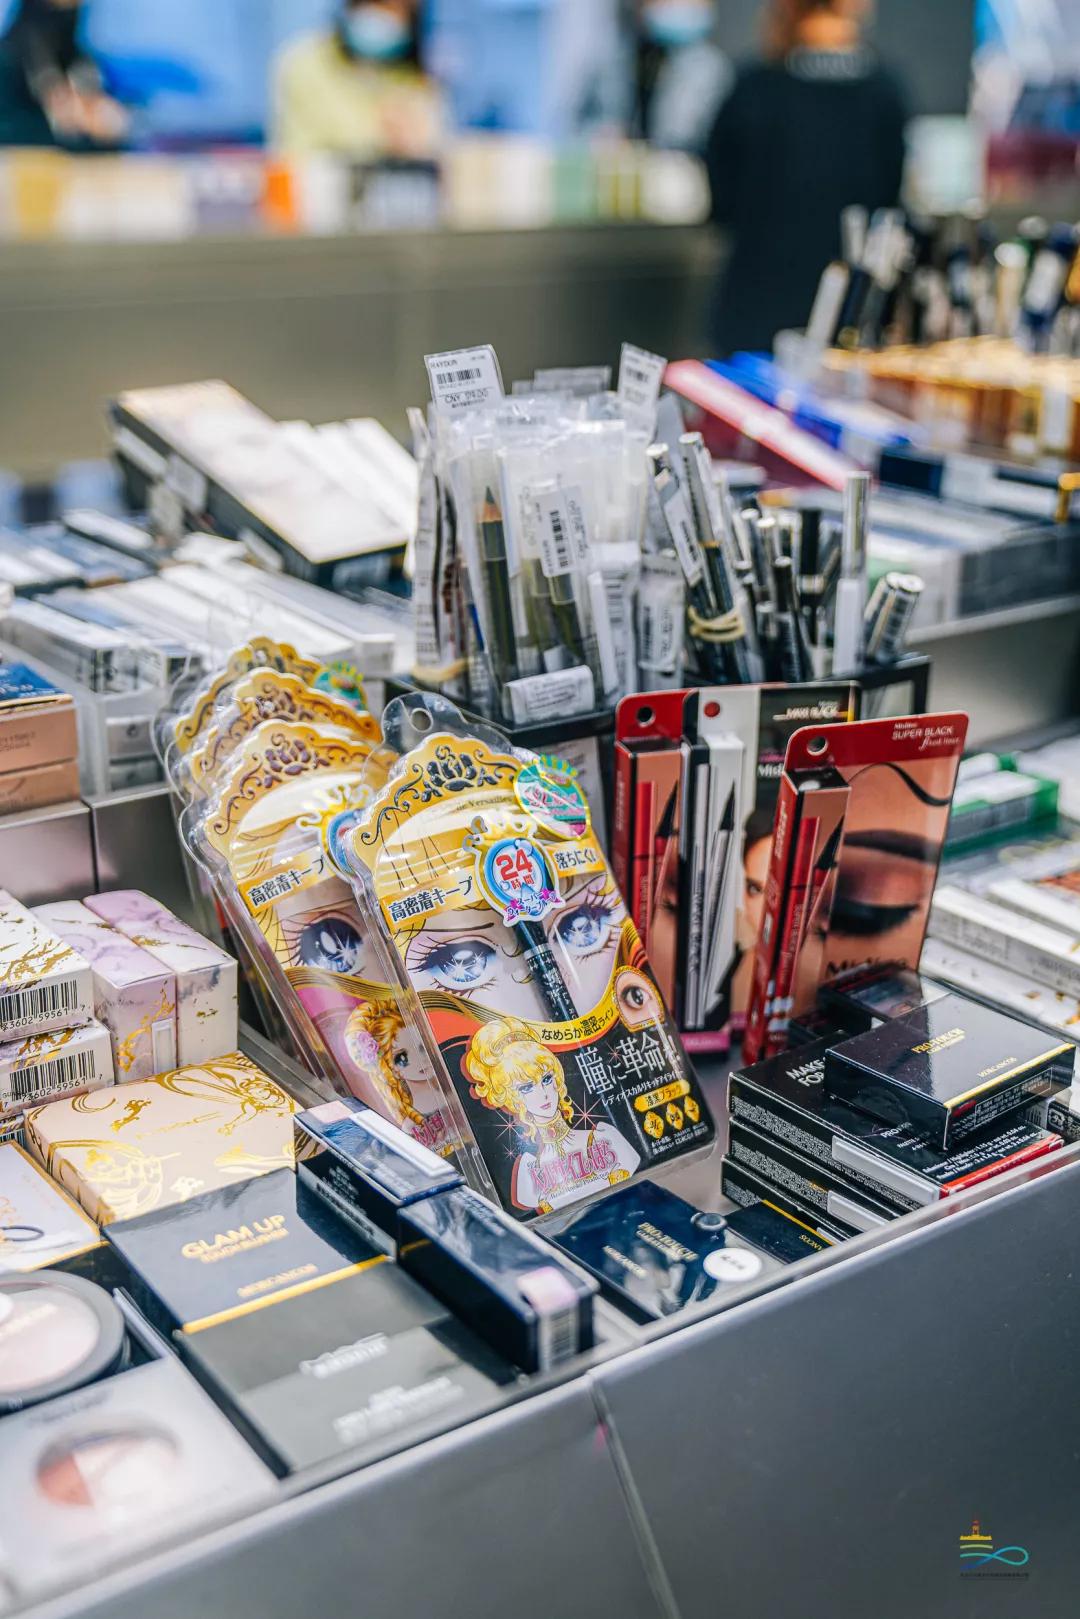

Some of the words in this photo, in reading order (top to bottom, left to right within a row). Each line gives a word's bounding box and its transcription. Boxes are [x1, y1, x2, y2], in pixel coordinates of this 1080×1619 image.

[892, 729, 923, 741] SUPER
[924, 725, 953, 737] BLACK
[248, 854, 324, 907] 高密着キープ
[496, 849, 532, 880] 24
[388, 876, 473, 922] 高密着キープ
[39, 1008, 69, 1022] 59561
[541, 1008, 614, 1041] なめらか濃密ライン
[181, 1226, 254, 1259] GLAM
[253, 1214, 286, 1234] UP
